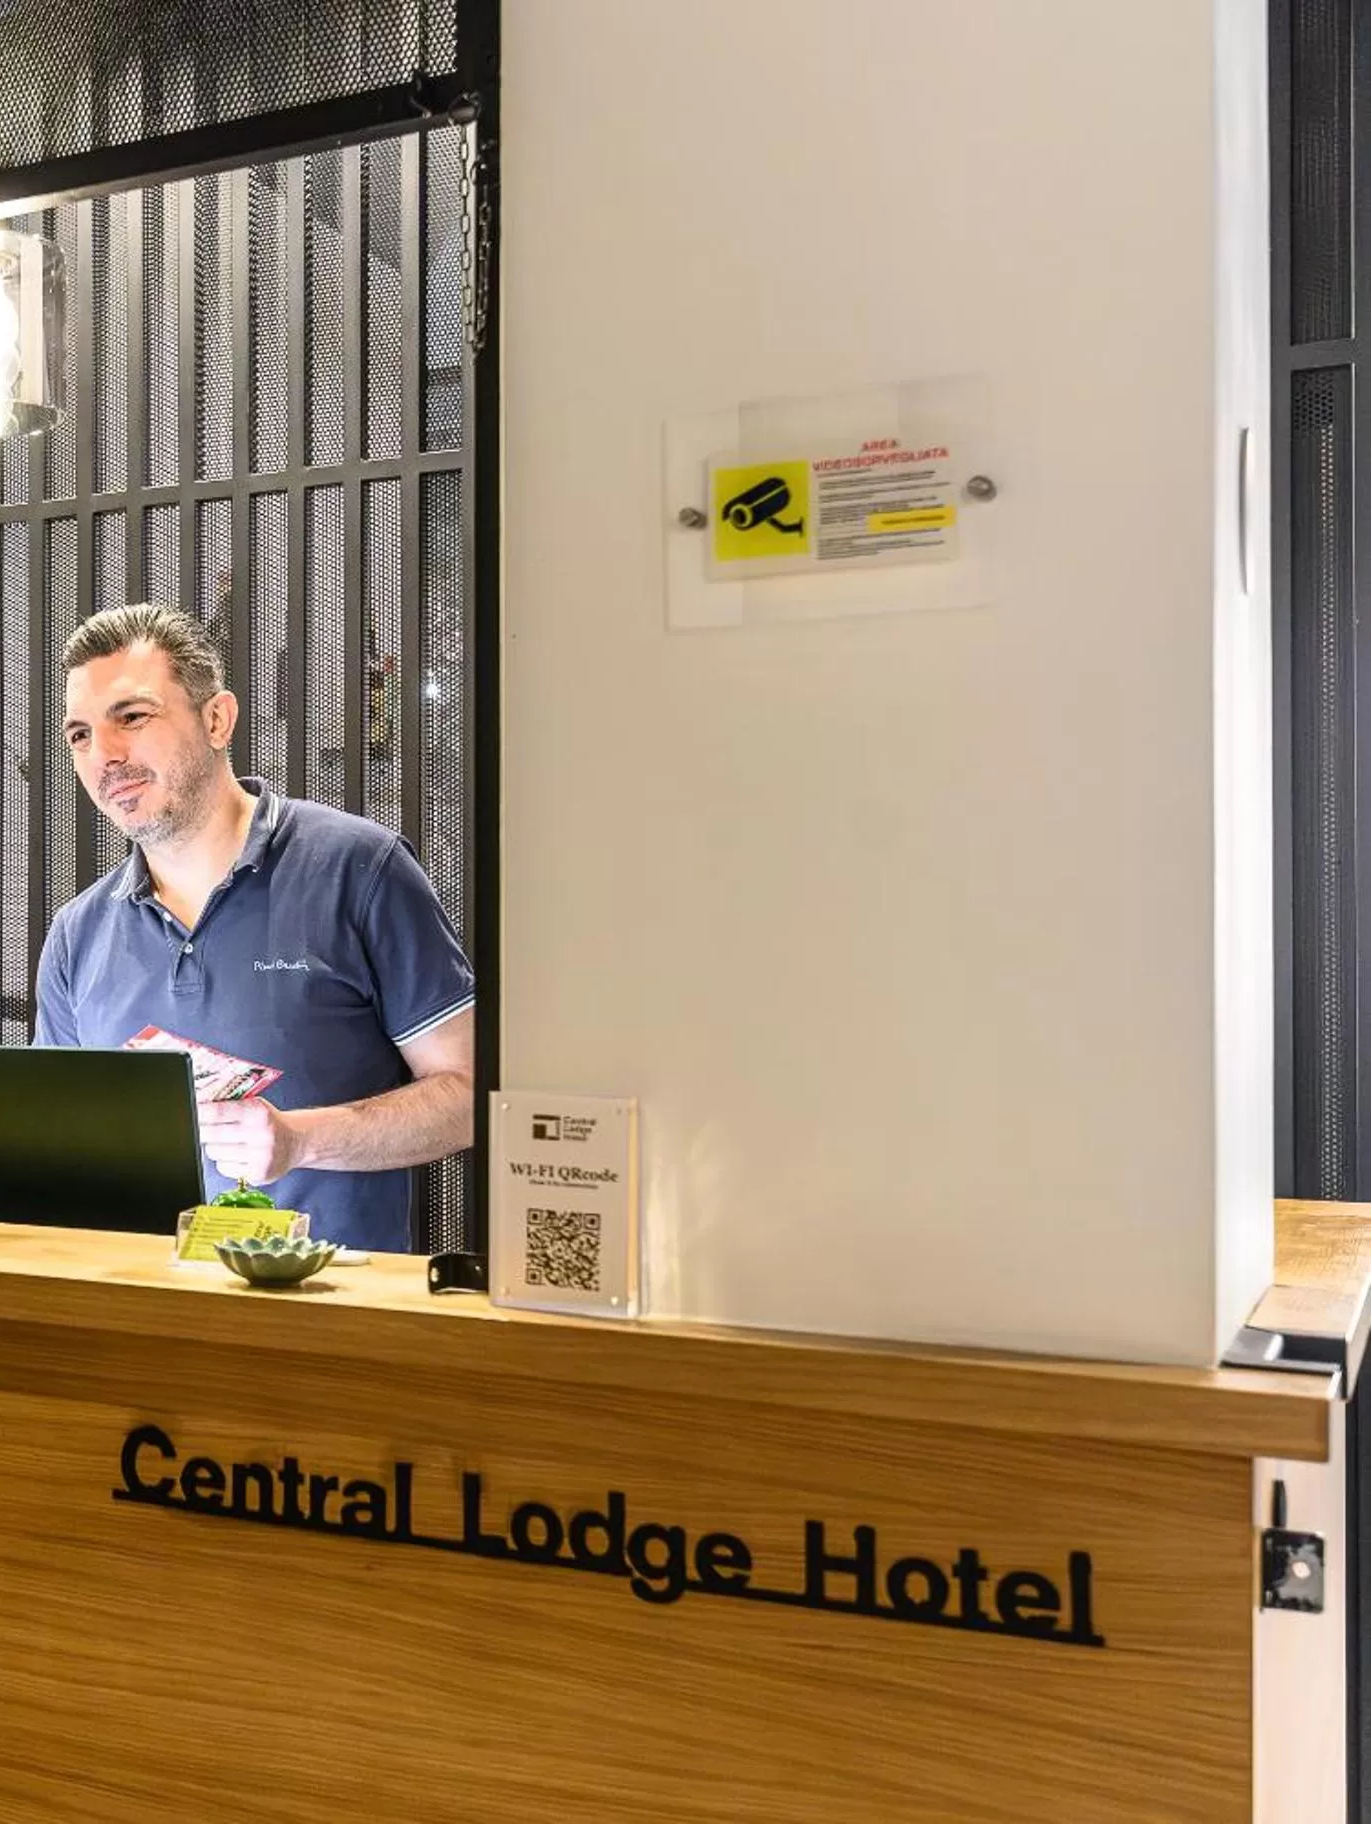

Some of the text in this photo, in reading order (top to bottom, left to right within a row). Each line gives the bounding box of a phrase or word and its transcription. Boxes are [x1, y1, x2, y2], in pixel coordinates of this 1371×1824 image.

[509, 1161, 619, 1183] WI-FI QRcode
[118, 1423, 1096, 1642] Central Lodge Hotel
